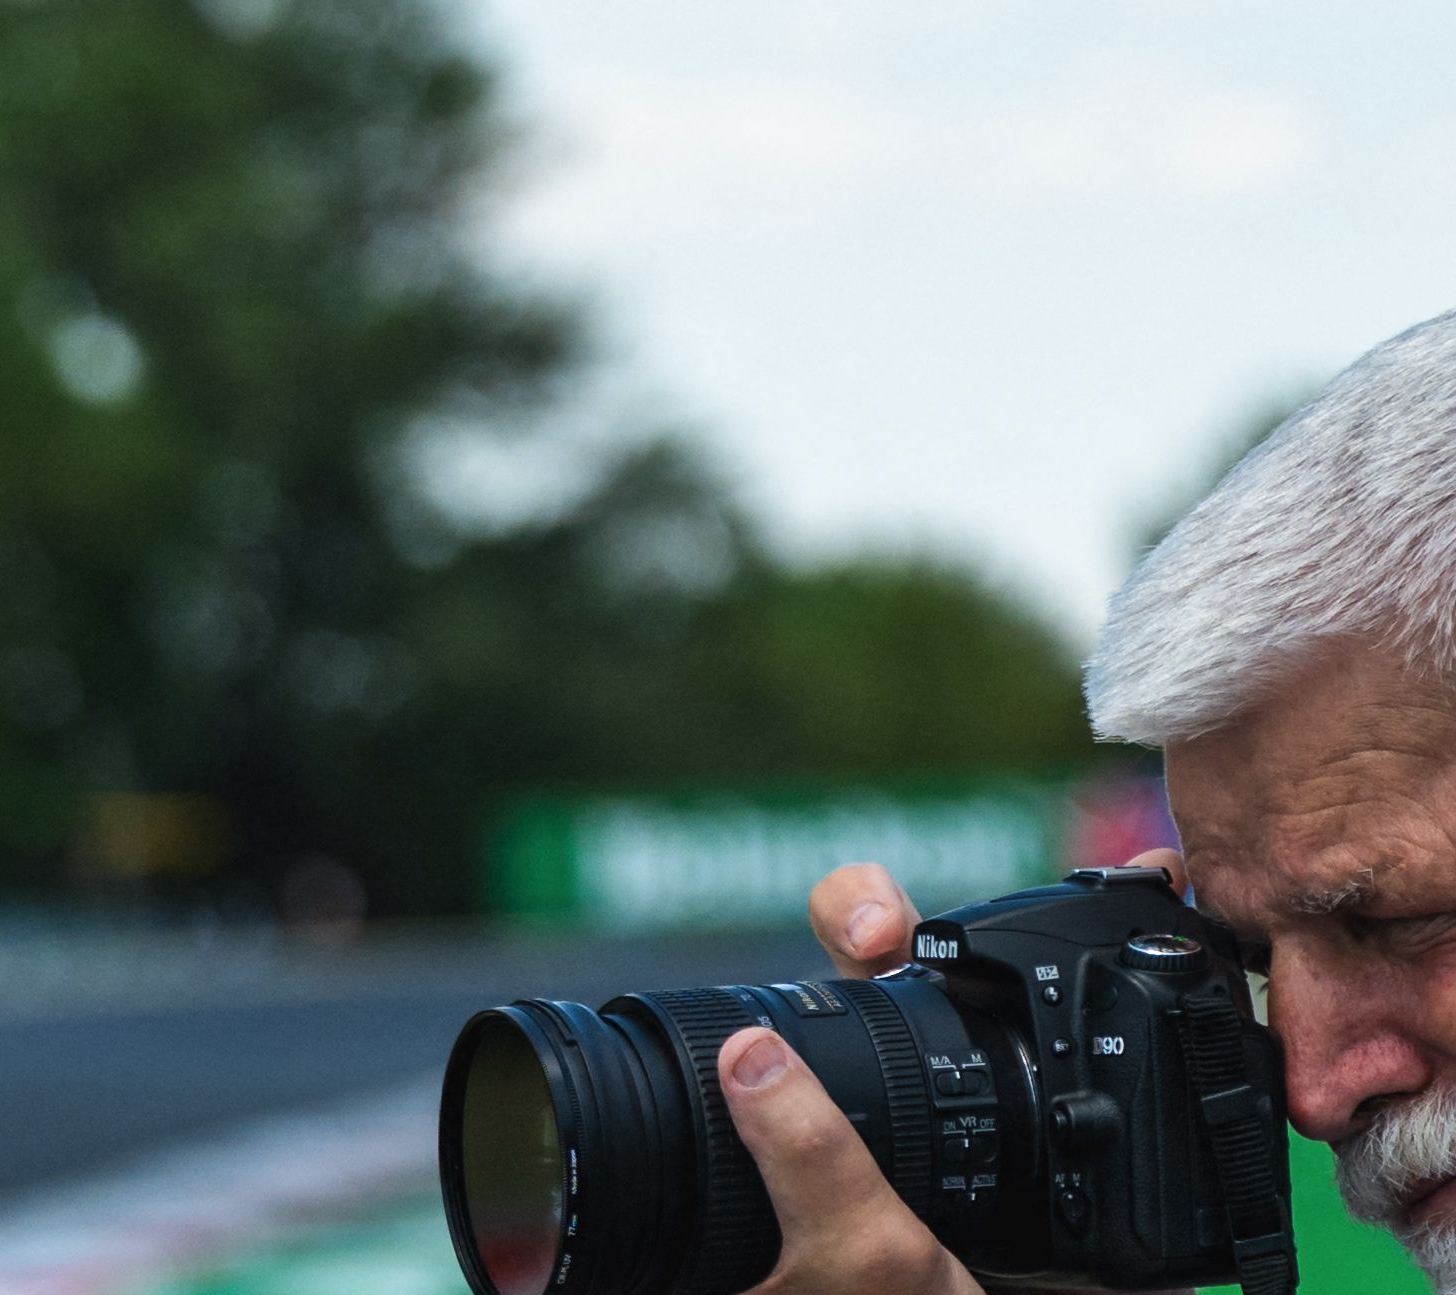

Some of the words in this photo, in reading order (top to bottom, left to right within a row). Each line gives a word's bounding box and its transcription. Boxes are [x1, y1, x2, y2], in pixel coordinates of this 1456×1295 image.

[917, 934, 959, 959] Nikon
[1092, 1036, 1125, 1056] D90
[930, 1055, 952, 1066] M/A
[971, 1053, 983, 1064] M
[943, 1120, 956, 1132] ON
[959, 1116, 977, 1128] VR
[979, 1118, 996, 1129] OFF
